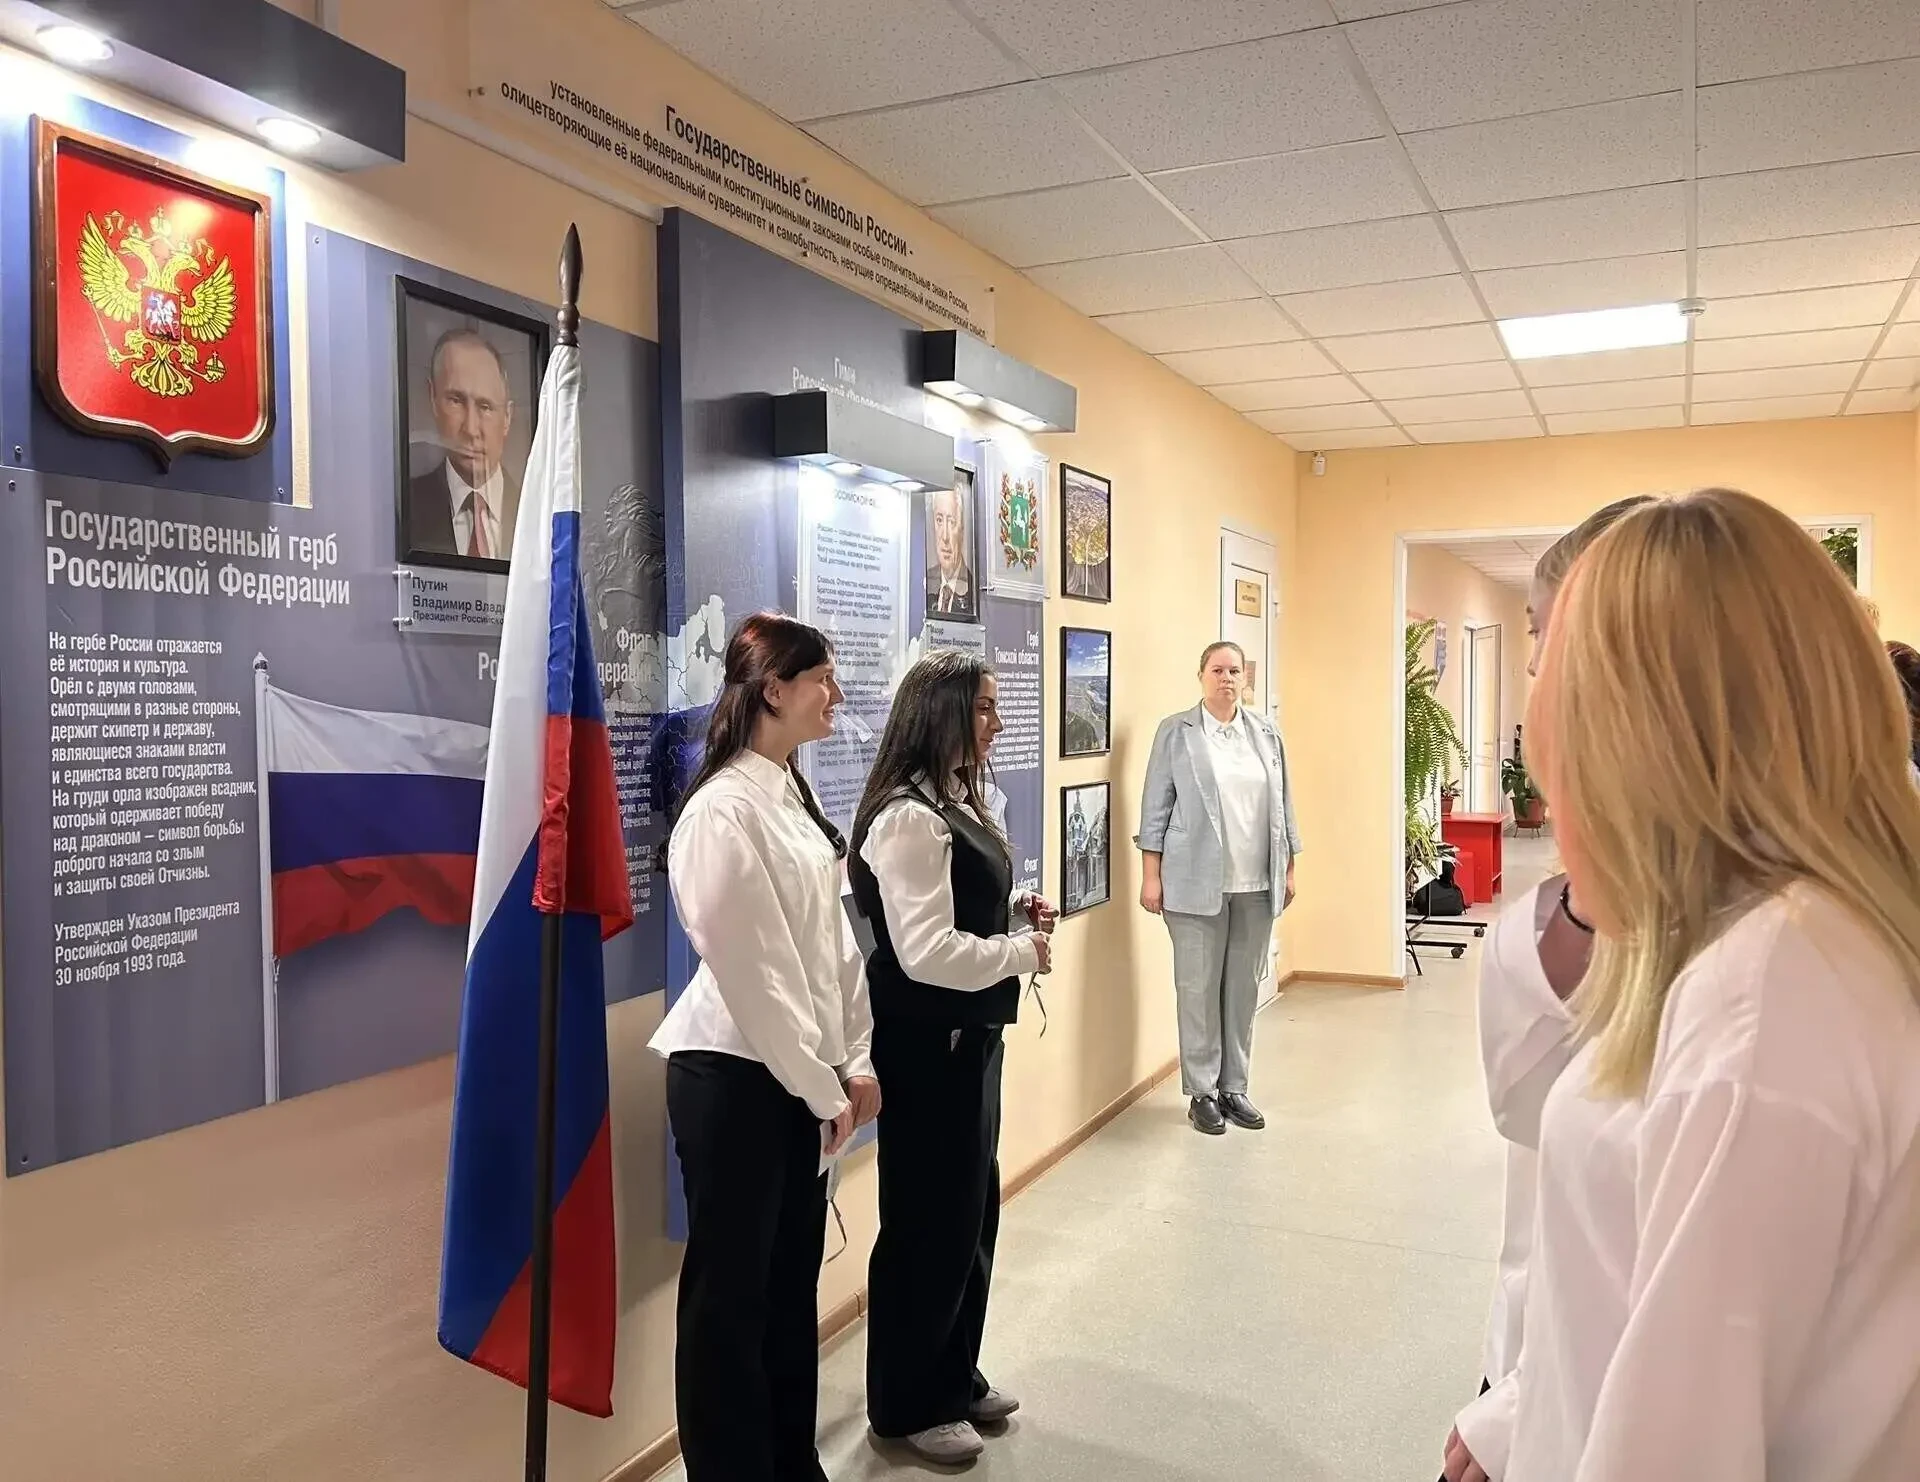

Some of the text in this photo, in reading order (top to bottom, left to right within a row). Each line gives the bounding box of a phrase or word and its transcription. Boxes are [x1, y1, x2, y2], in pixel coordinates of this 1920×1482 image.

[501, 82, 612, 152] олицетворяющие
[614, 141, 628, 160] её
[630, 151, 706, 201] национальный
[708, 191, 766, 231] суверенитет
[768, 223, 775, 234] и
[776, 225, 840, 264] самобытность,
[840, 256, 874, 281] несущие
[550, 80, 641, 142] установленные
[643, 130, 722, 187] федеральными
[723, 176, 811, 230] конституционными
[812, 222, 851, 249] законами
[852, 242, 881, 264] особые
[881, 256, 931, 291] отличительные
[666, 105, 801, 200] Государственные
[805, 188, 863, 233] символы
[866, 215, 907, 256] России
[45, 498, 338, 571] Государственный герб
[46, 546, 350, 608] Российской Федерации
[413, 577, 448, 592] Путин
[413, 595, 472, 612] Владимир
[413, 611, 459, 621] Президент
[49, 632, 222, 655] На гербе России отражается
[50, 654, 188, 677] её история и культура.
[50, 676, 197, 697] Орёл с двумя головами,
[51, 702, 240, 719] смотрящими в разные стороны,
[52, 722, 215, 742] держит скипетр и державу,
[52, 742, 226, 762] являющиеся знаками власти
[53, 763, 233, 786] и единства всего государства.
[53, 782, 256, 808] На груди орла изображен всадник,
[53, 803, 224, 830] который одерживает победу
[53, 835, 77, 853] над
[81, 832, 140, 851] драконом
[159, 826, 200, 841] символ
[204, 820, 244, 837] борьбы
[54, 846, 204, 876] доброго начала со злым
[54, 866, 210, 896] и защиты своей Отчизны.
[55, 902, 239, 941] Утвержден Указом Президента
[55, 929, 198, 963] Российской Федерации
[56, 952, 186, 986] 30 ноября 1993 года.
